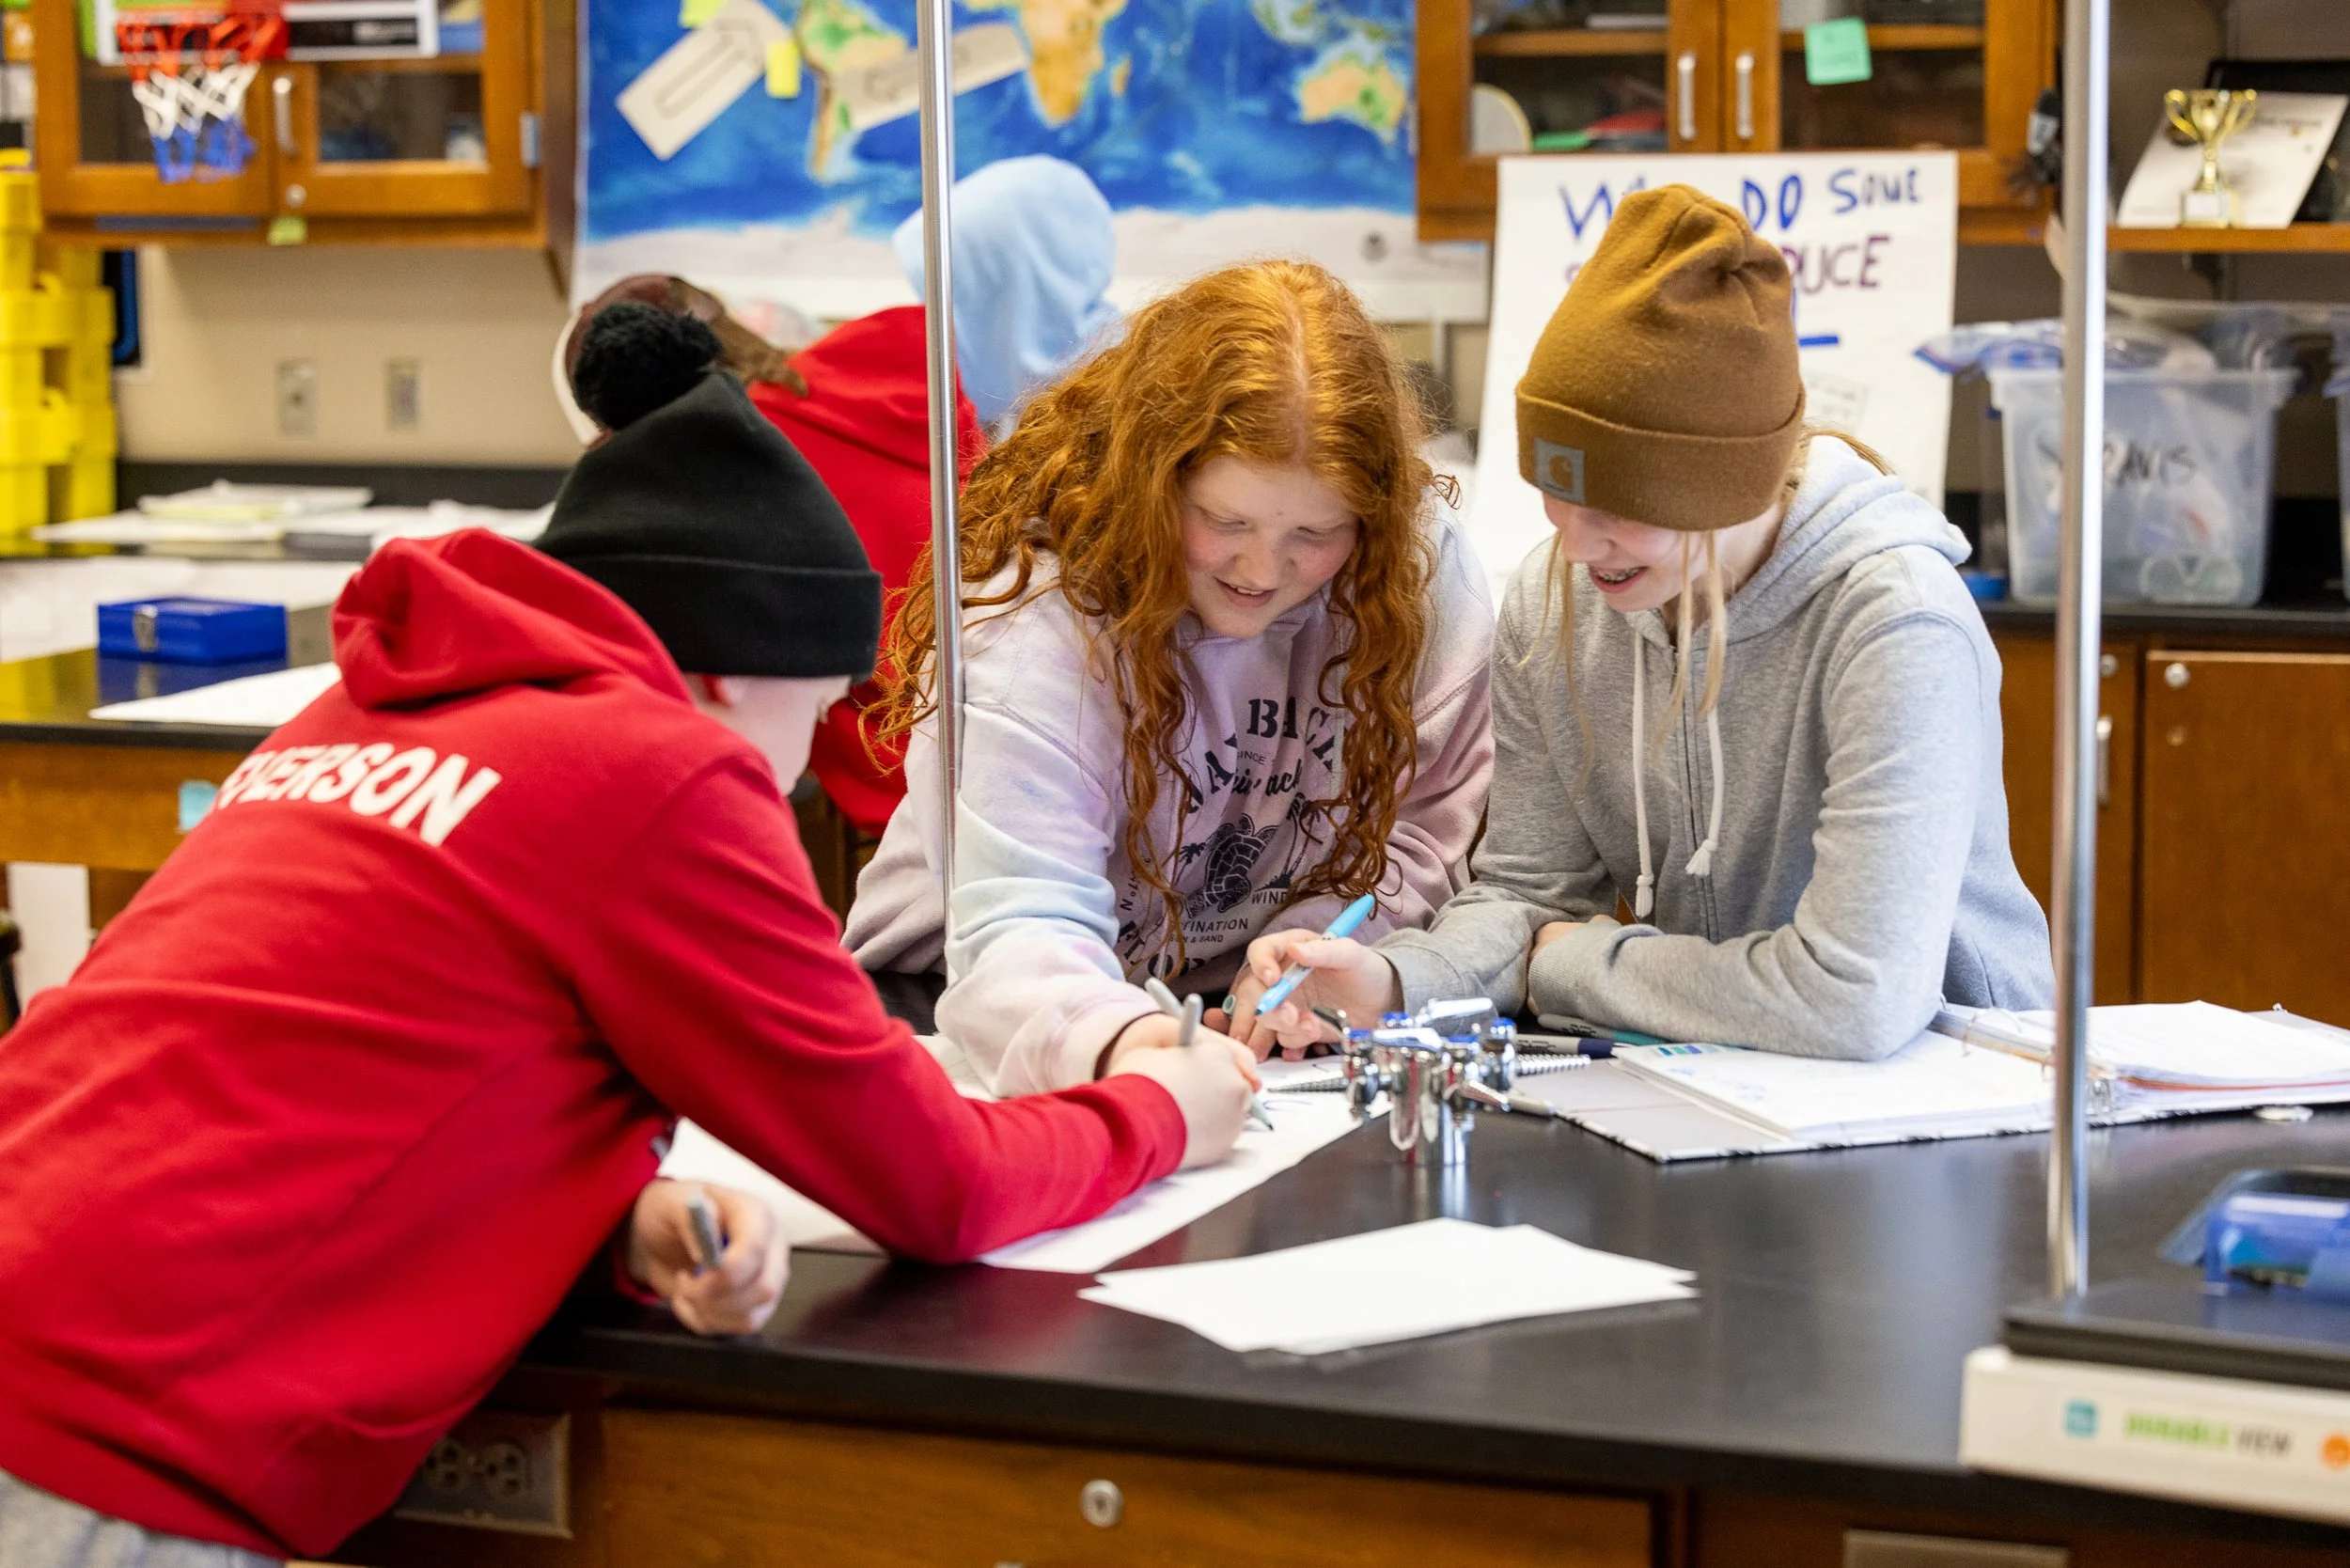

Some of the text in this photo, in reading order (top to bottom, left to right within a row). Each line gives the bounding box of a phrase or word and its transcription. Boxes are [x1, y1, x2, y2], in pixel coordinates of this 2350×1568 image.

[1741, 173, 1803, 231] DO
[1181, 917, 1249, 933] TINATION
[1198, 934, 1224, 943] SAND
